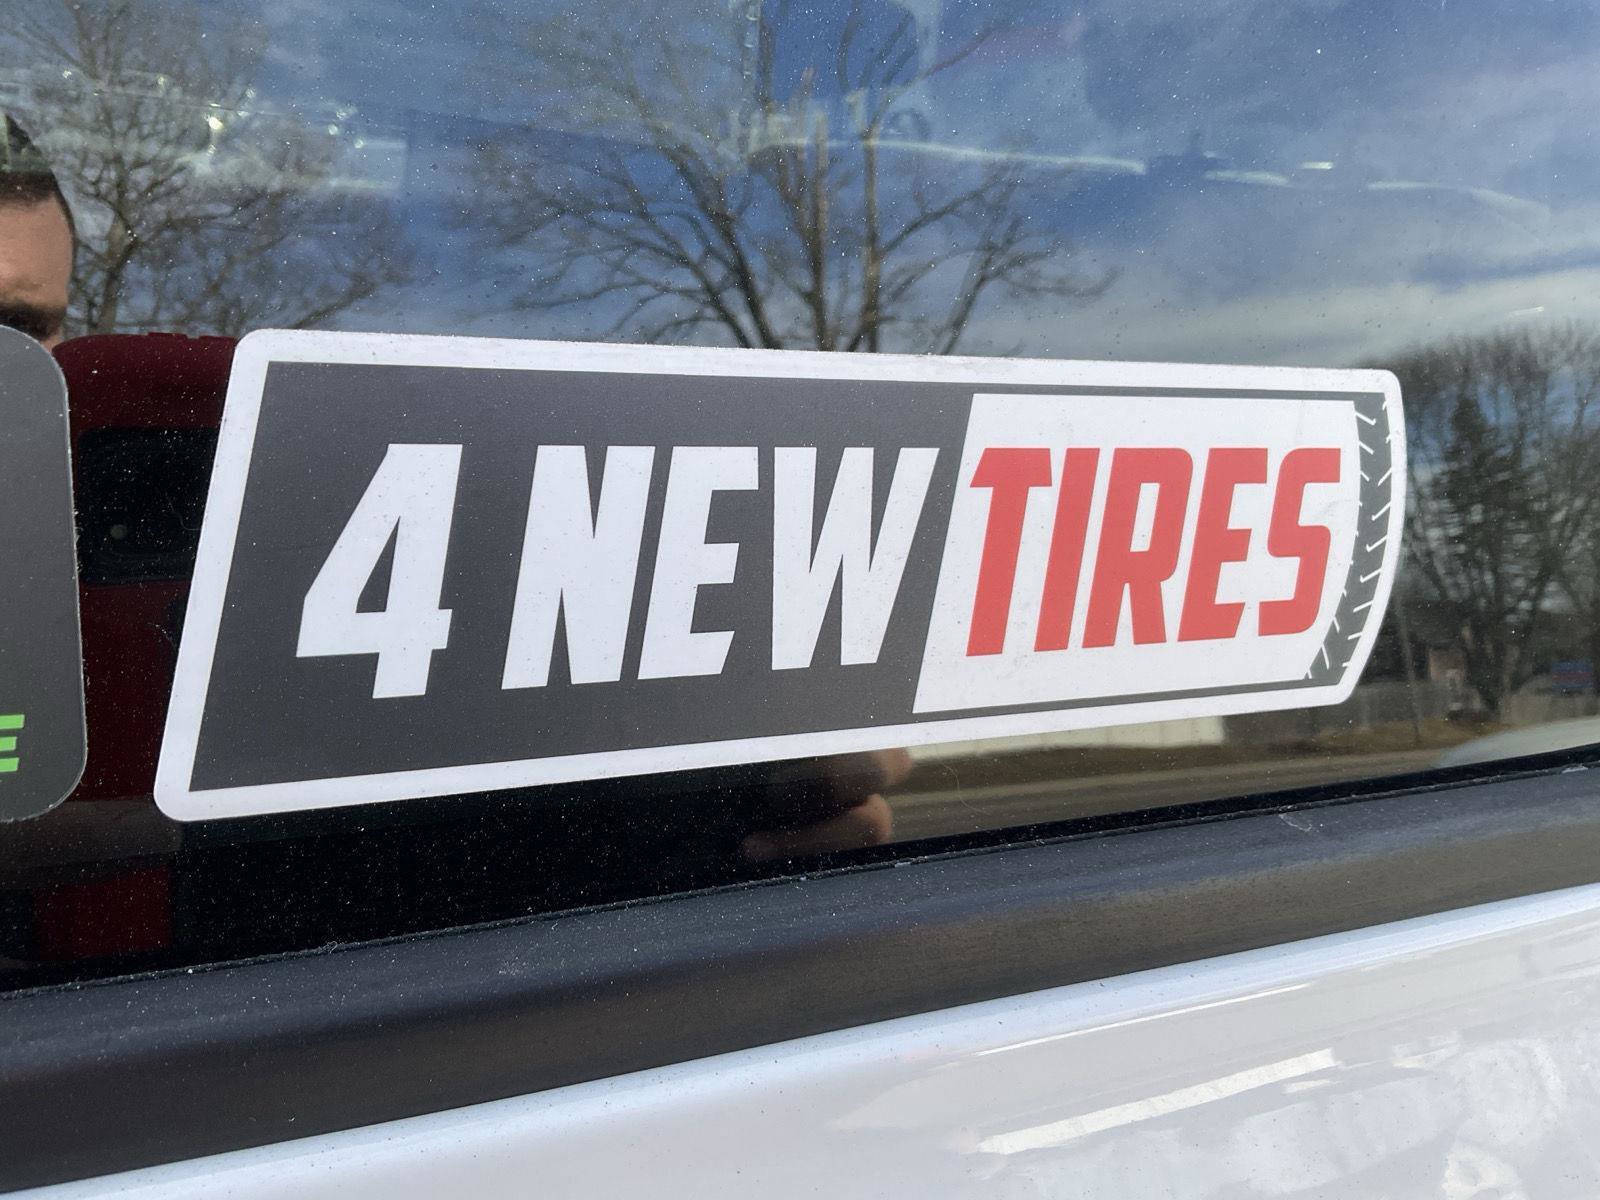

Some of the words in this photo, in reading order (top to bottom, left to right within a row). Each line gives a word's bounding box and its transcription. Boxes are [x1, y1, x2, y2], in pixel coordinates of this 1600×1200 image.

[296, 443, 464, 699] 4
[502, 444, 940, 690] NEW
[967, 447, 1341, 657] TIRES
